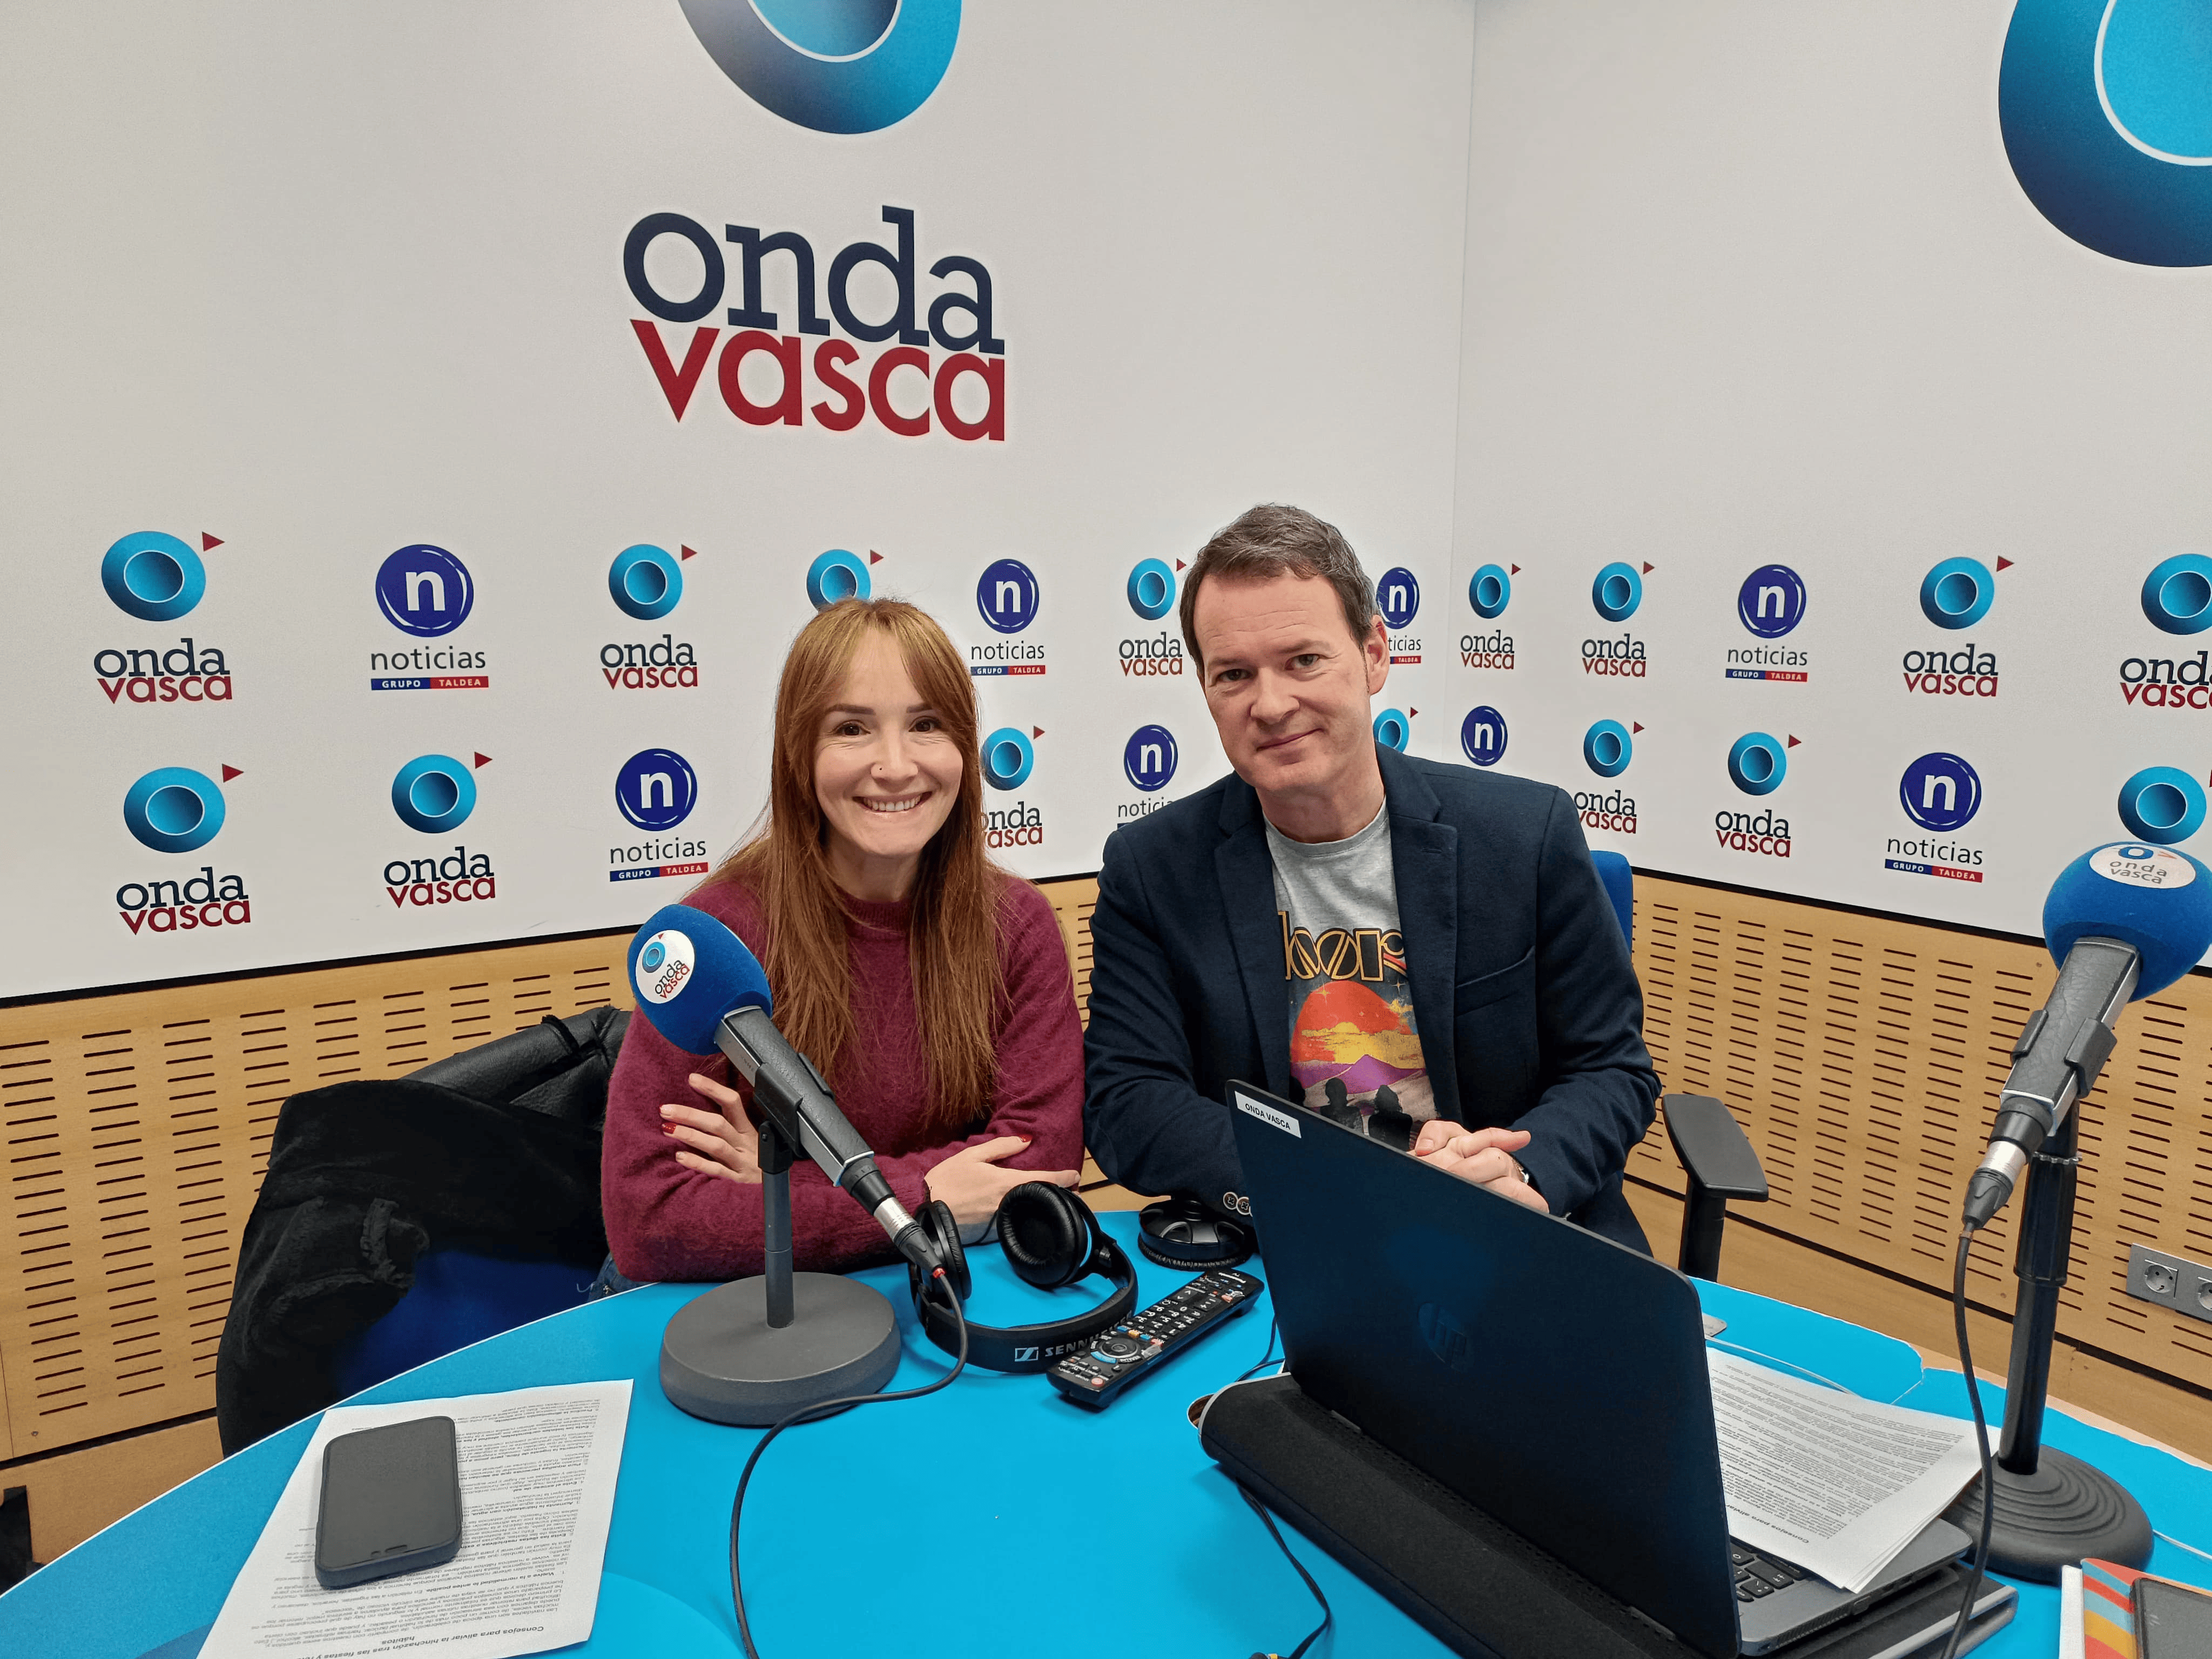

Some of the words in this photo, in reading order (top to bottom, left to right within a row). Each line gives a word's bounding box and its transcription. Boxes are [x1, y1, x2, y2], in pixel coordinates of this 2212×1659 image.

[624, 205, 1005, 355] onda
[630, 319, 1005, 442] vasca
[600, 634, 697, 668] onda
[970, 640, 1045, 660] noticias
[1119, 631, 1183, 659] onda
[1387, 635, 1421, 651] ticias
[1460, 630, 1515, 654] onda
[1582, 633, 1647, 660] onda
[93, 638, 230, 678] onda
[371, 645, 485, 671] noticias
[1120, 658, 1183, 677] vasca
[1461, 652, 1514, 670] vasca
[1582, 658, 1646, 677] vasca
[1728, 645, 1808, 666] noticias
[1903, 643, 1999, 676] onda
[2120, 650, 2212, 686] ond
[382, 679, 421, 689] GRUPO
[439, 678, 481, 687] TALDEA
[603, 666, 699, 690] vasca
[1771, 672, 1802, 680] TALDEA
[1903, 673, 1998, 697] vasca
[97, 676, 233, 704] vasca
[2120, 682, 2212, 709] vasc
[1574, 790, 1637, 818] onda
[987, 827, 1042, 848] asca
[1715, 809, 1791, 840] onda
[610, 837, 706, 864] noticias
[1716, 830, 1791, 858] vasca
[1887, 838, 1983, 865] noticias
[383, 846, 495, 886] onda
[618, 869, 652, 879] GRUPO
[666, 865, 702, 874] TALDEA
[1893, 862, 1924, 872] GRUPO
[1939, 868, 1975, 880] TALDEA
[2109, 861, 2167, 877] onda
[2110, 868, 2162, 884] vasca
[116, 866, 249, 911] onda
[387, 876, 496, 908] vasca
[120, 900, 251, 935] vasca
[655, 960, 685, 994] onda
[659, 964, 690, 999] vasca
[1245, 1103, 1265, 1118] ONDA
[1266, 1112, 1291, 1130] VASCA
[1725, 1505, 1750, 1516] aliviar
[1751, 1516, 1770, 1526] para
[1771, 1525, 1809, 1543] Consejos
[480, 1576, 517, 1584] normalidad
[382, 1636, 414, 1644] hábitos
[393, 1639, 439, 1649] hinchazón
